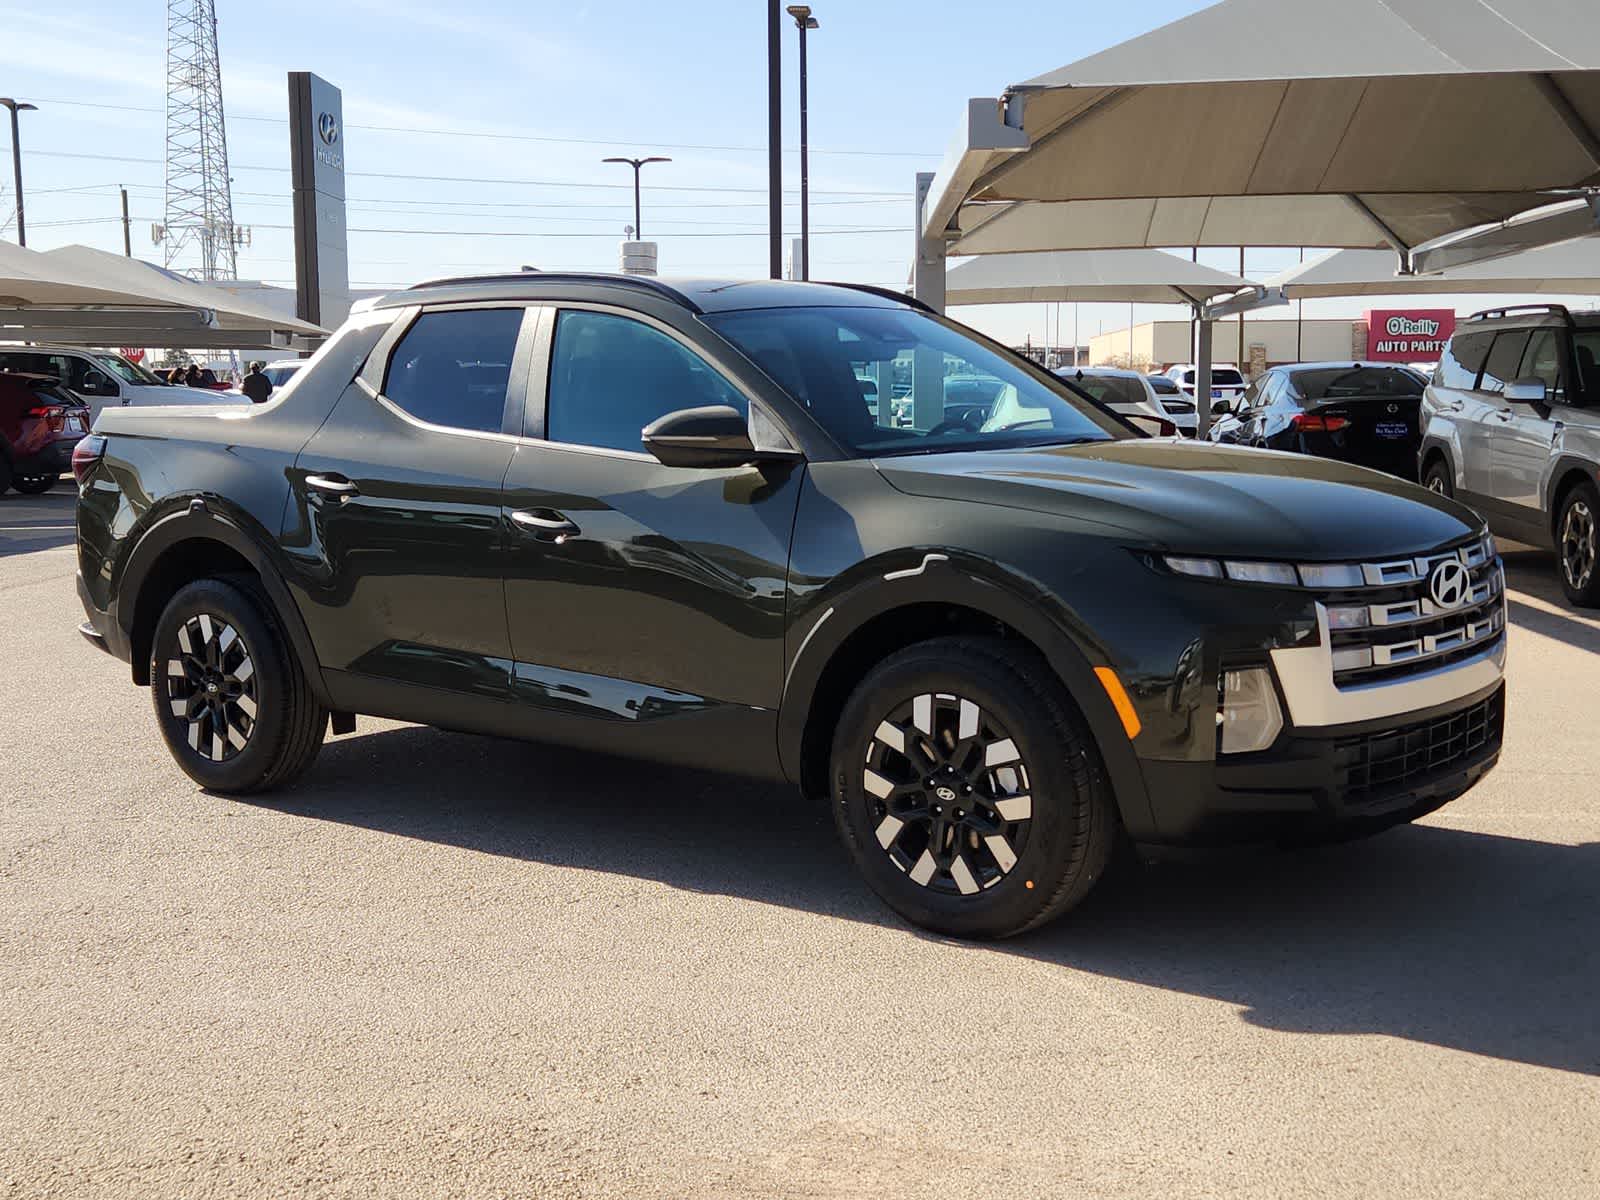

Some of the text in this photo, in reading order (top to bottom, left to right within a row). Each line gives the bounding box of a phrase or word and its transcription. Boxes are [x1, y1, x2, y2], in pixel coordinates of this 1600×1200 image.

[1387, 317, 1438, 335] O'Reilly
[121, 347, 143, 355] STOP
[1377, 341, 1447, 352] AUTO PARTS
